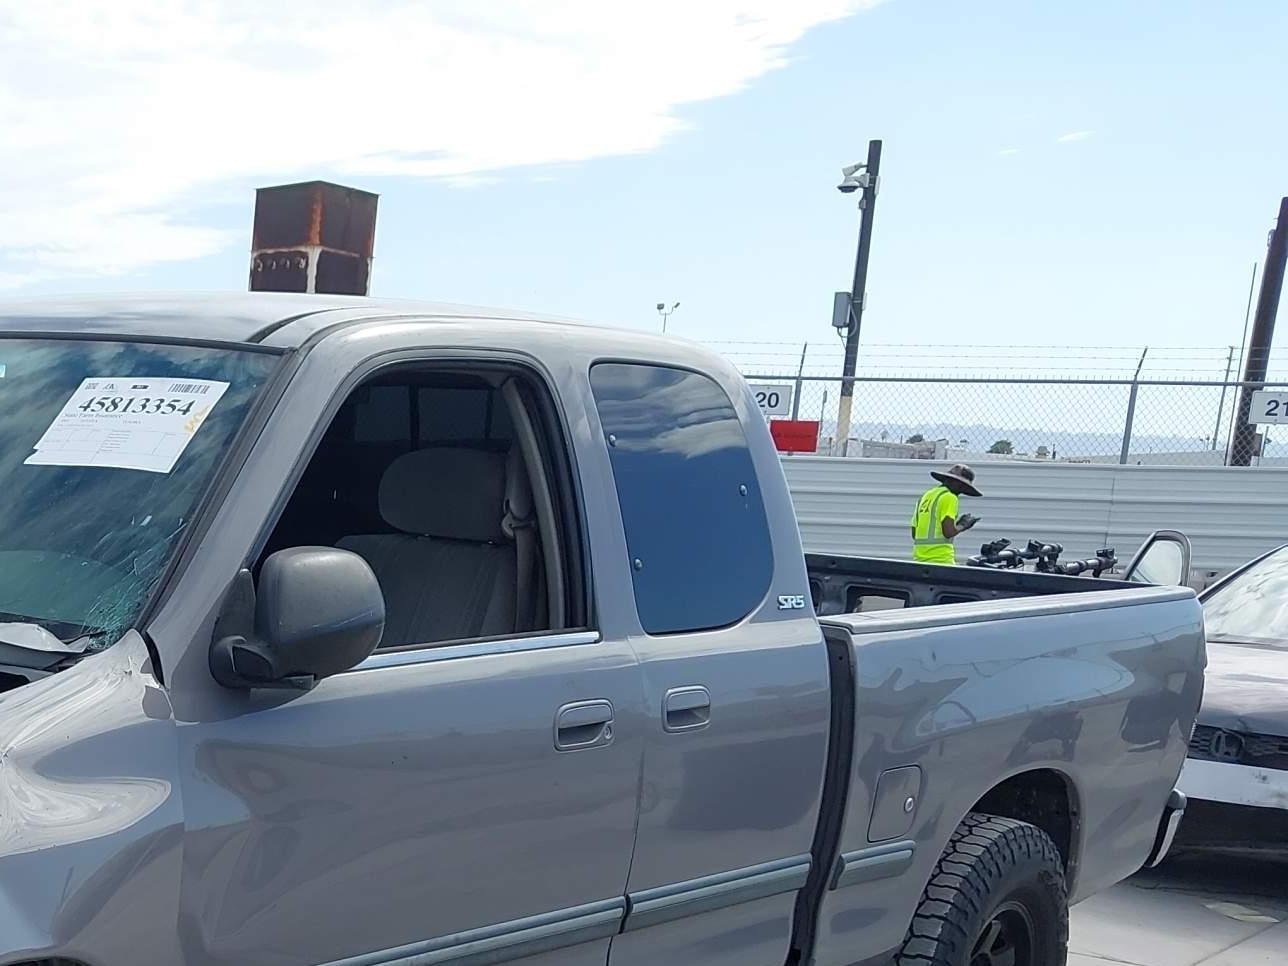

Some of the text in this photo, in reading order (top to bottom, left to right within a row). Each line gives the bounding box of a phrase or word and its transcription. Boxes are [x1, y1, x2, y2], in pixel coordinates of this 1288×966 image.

[78, 396, 196, 416] 45813354
[755, 391, 779, 408] 20
[1264, 399, 1288, 417] 21
[778, 595, 805, 609] SR5
